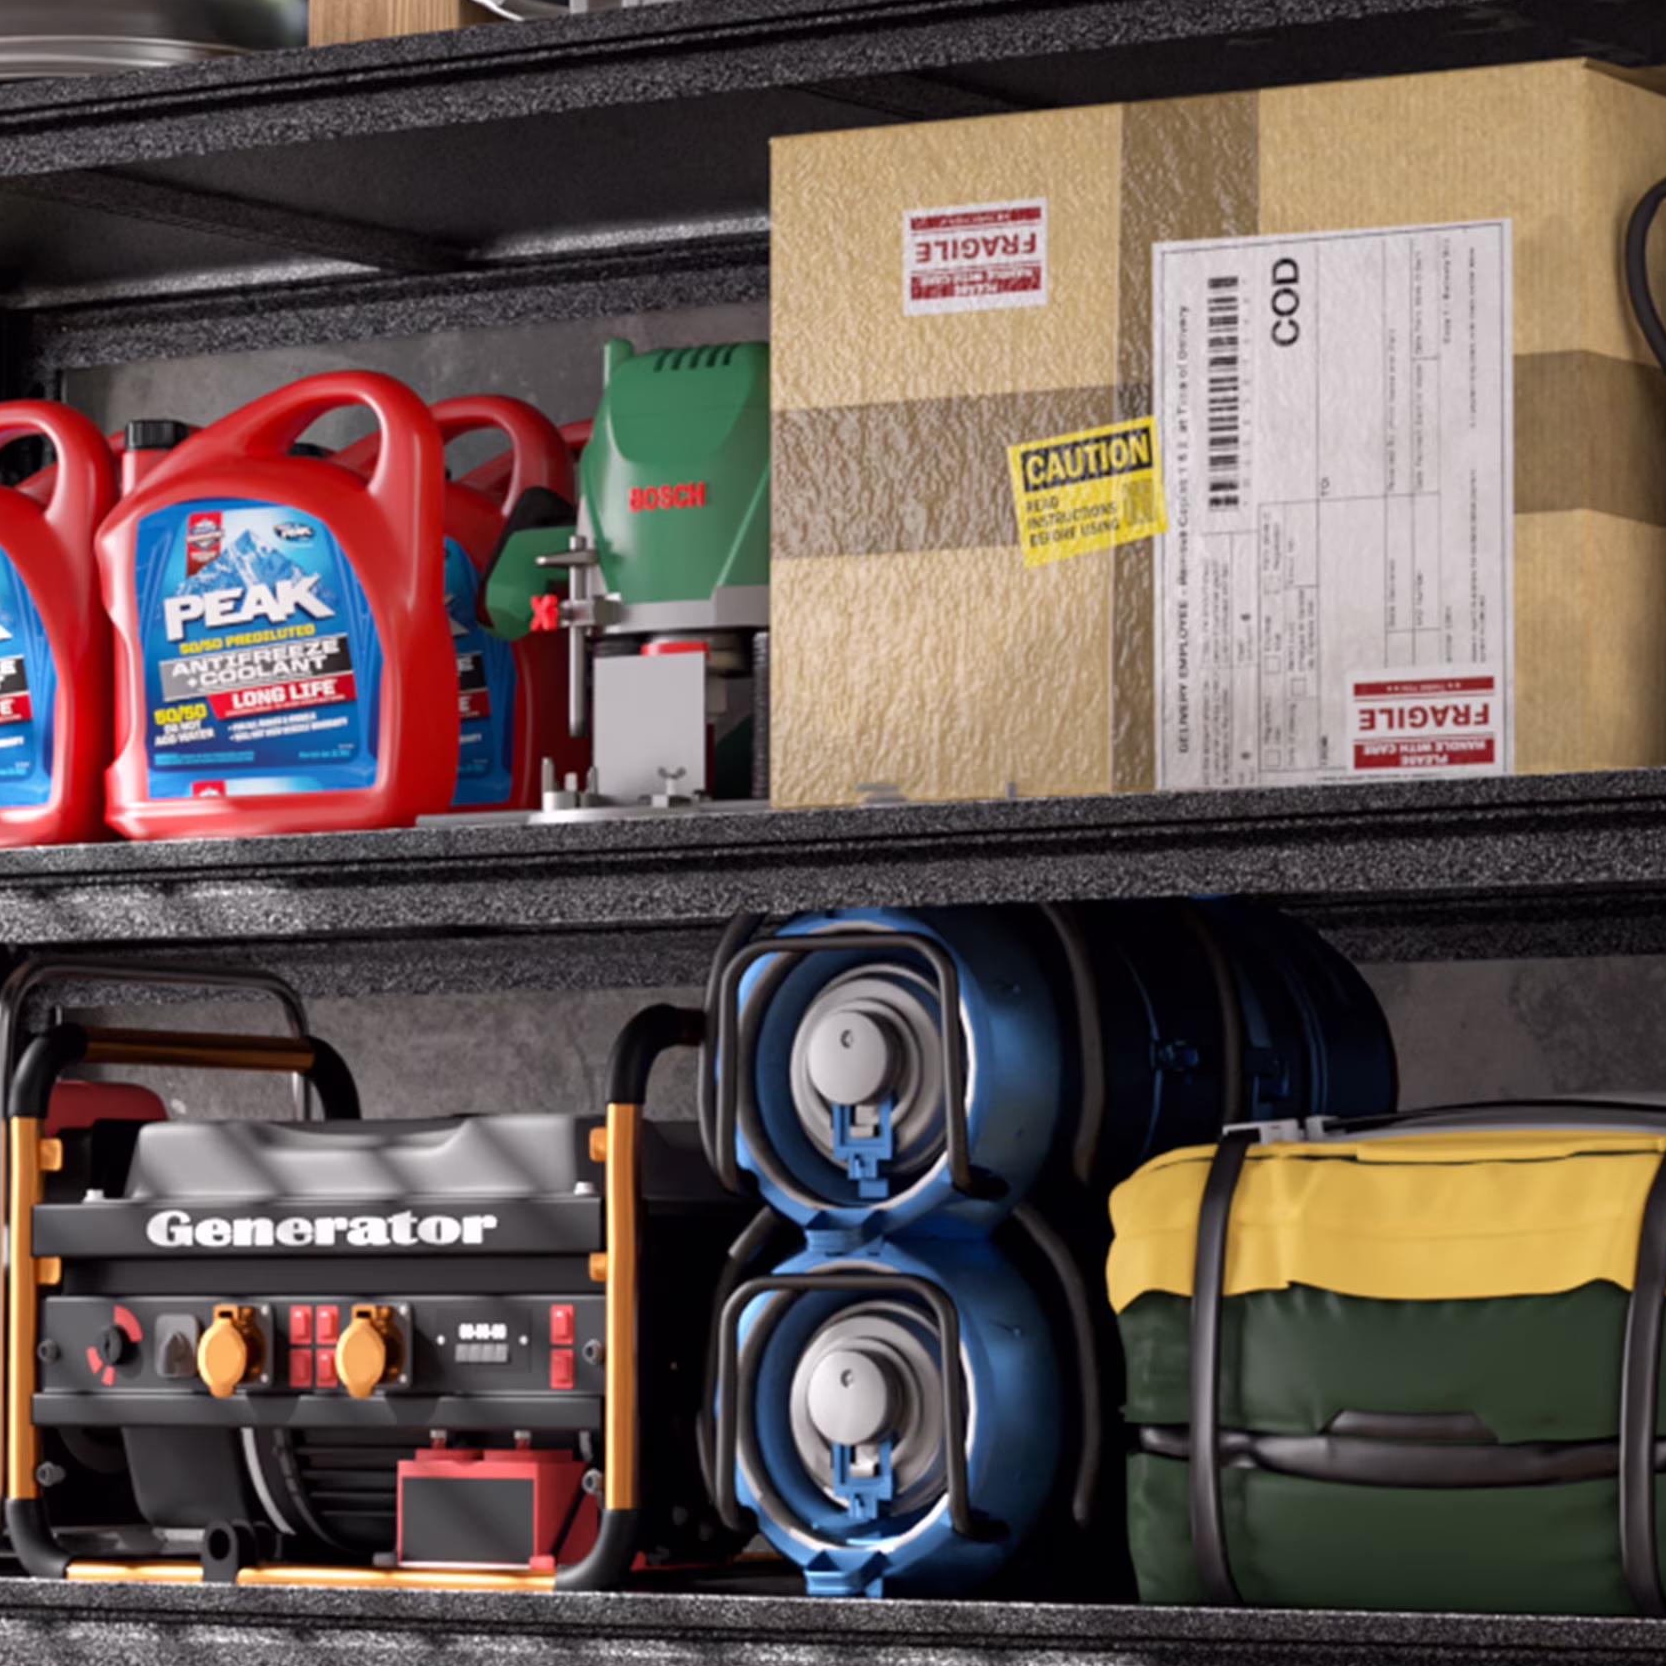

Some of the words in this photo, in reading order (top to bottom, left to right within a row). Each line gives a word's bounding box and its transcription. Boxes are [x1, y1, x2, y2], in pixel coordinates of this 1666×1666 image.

[915, 233, 1037, 263] FRAGILE
[1271, 257, 1300, 347] COD
[1026, 433, 1151, 486] CAUTION
[629, 481, 706, 512] BOSCH
[1027, 501, 1117, 529] INSTRUCTIONS
[1081, 518, 1120, 536] USING
[164, 573, 336, 642] PEAK
[225, 623, 316, 648] PREDILUTED
[1178, 601, 1188, 678] EMPLOYEE
[171, 636, 340, 677] ANTIFREEZE
[231, 686, 287, 710] LONG
[290, 679, 336, 699] LIFE
[154, 703, 208, 725] 50/50
[1358, 703, 1490, 731] FRAGILE
[1399, 742, 1433, 754] WITH
[146, 1209, 498, 1247] Generator
